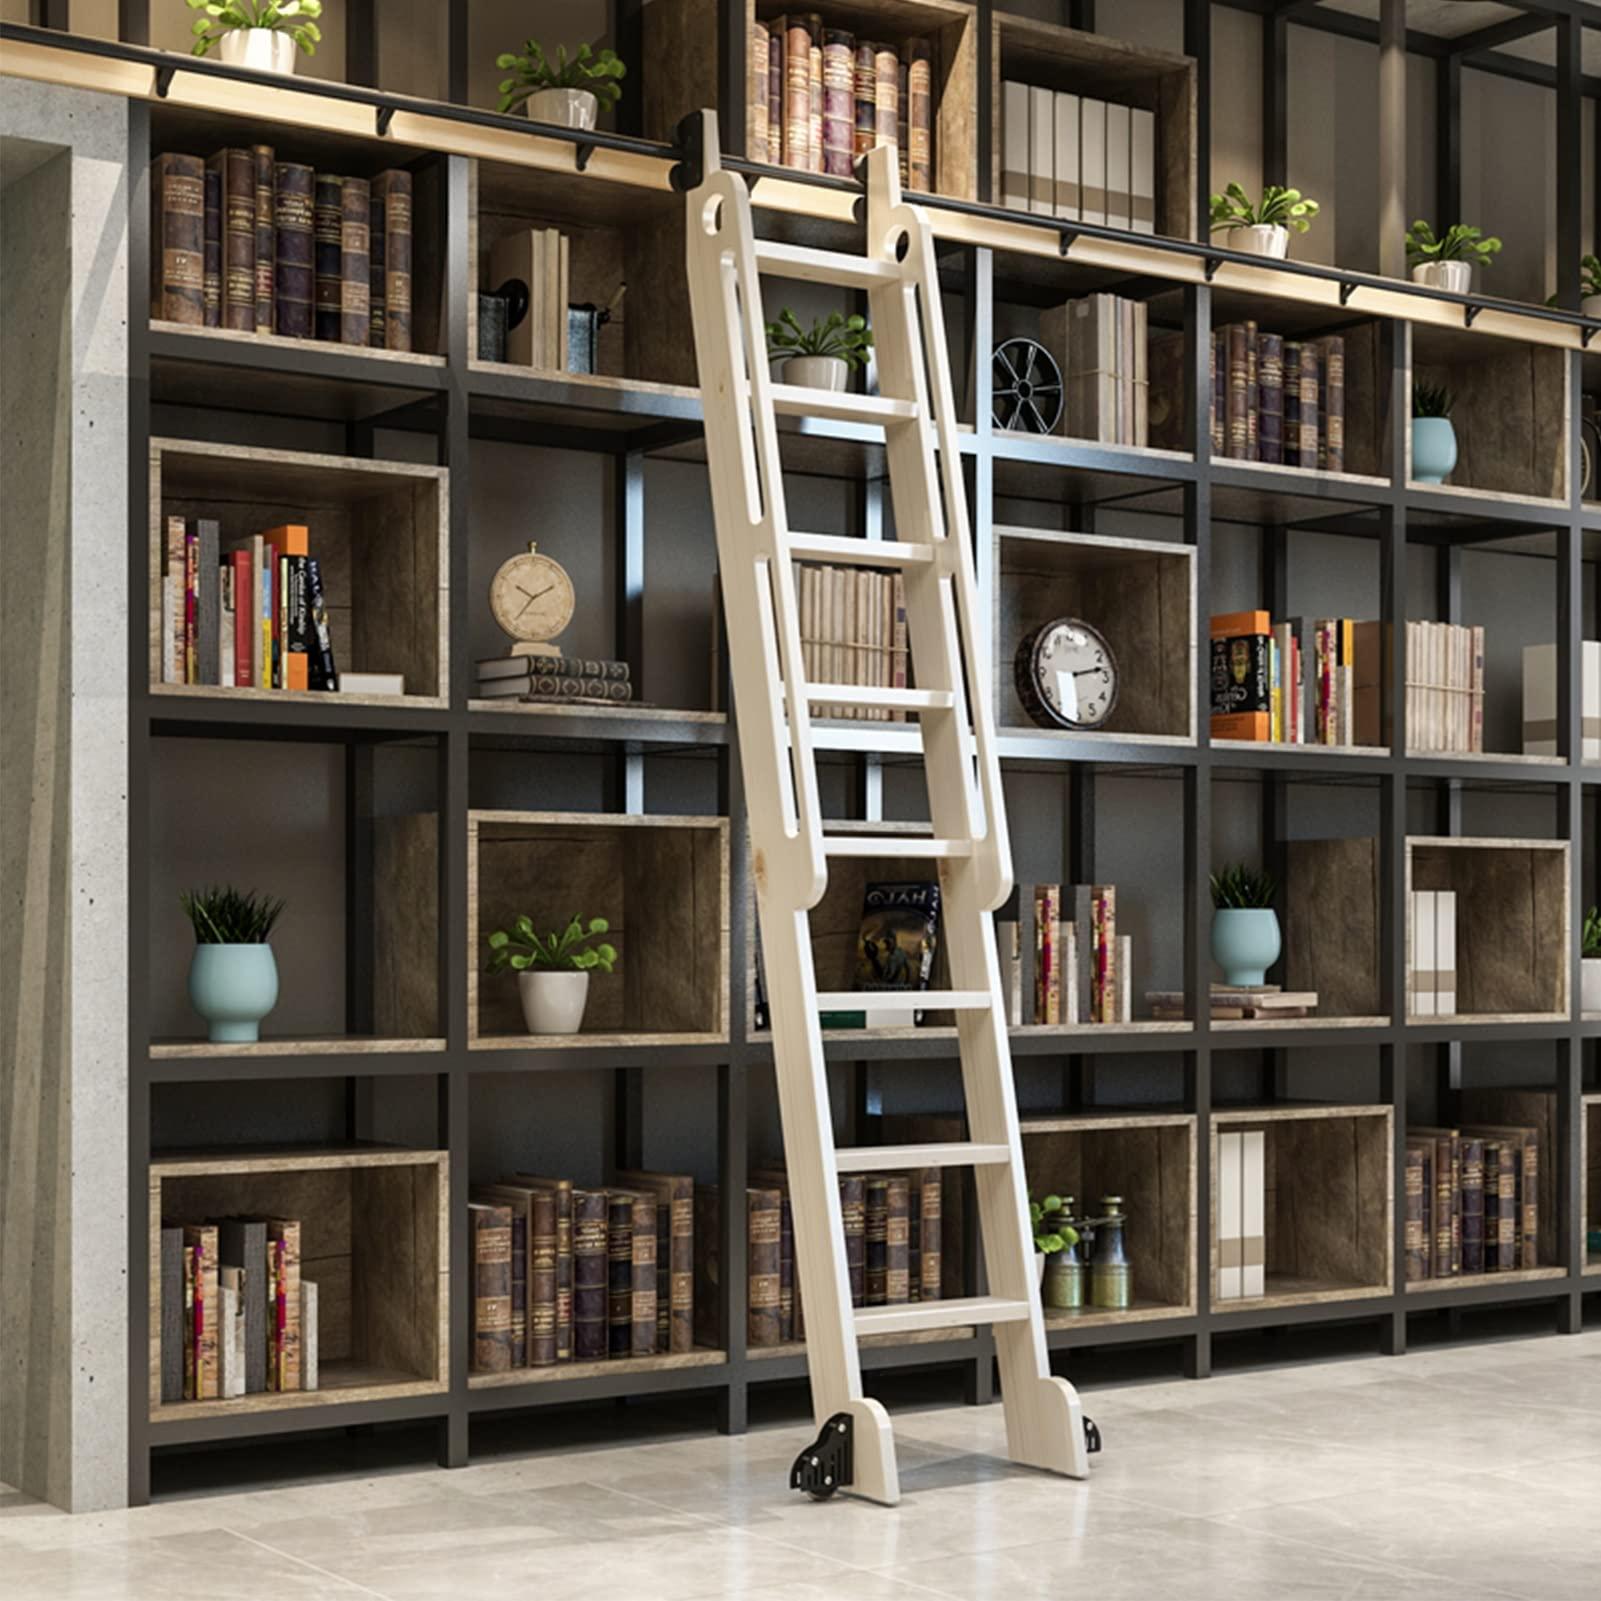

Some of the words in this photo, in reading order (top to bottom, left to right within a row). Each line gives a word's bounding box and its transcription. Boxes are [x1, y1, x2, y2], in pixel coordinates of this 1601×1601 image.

[297, 570, 307, 596] Genius
[1095, 649, 1103, 663] 2
[1101, 669, 1109, 684] 3
[1098, 691, 1106, 702] 4
[1088, 702, 1096, 717] 5
